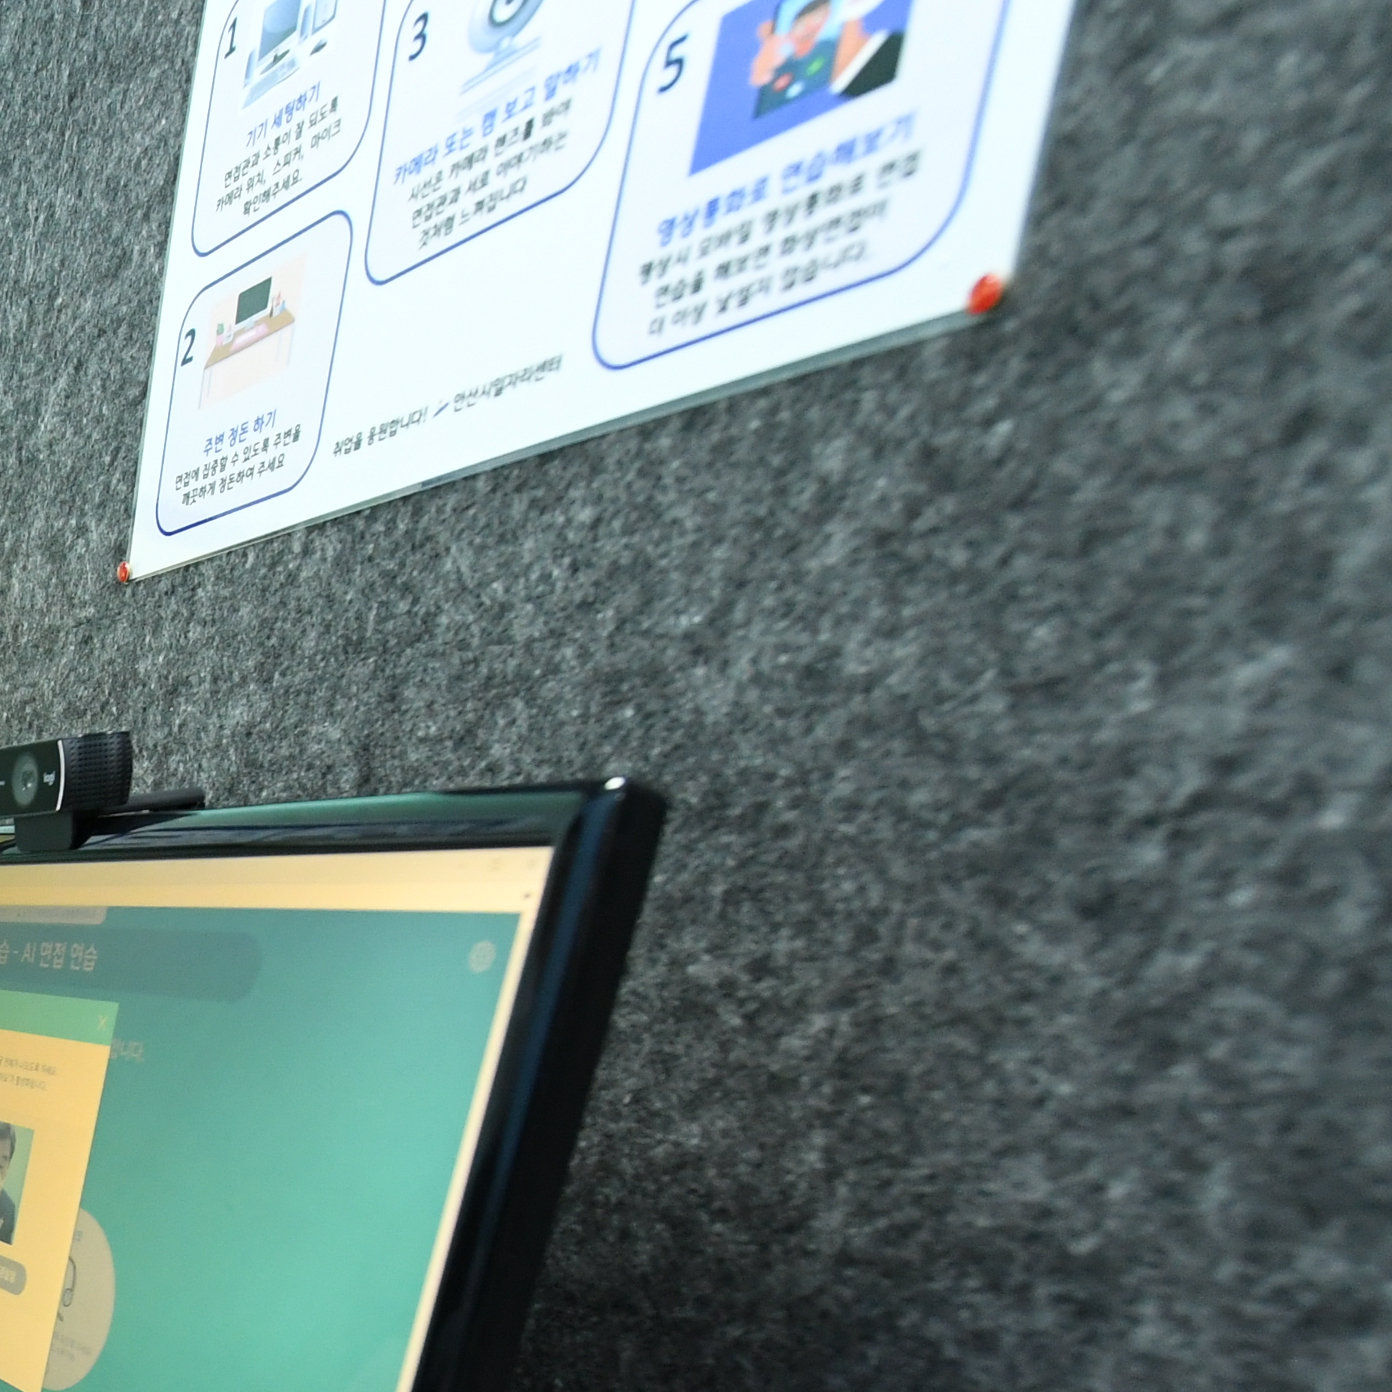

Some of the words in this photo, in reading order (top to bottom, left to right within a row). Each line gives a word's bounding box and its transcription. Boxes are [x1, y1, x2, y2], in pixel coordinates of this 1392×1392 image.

[224, 17, 237, 59] 1
[408, 11, 429, 61] 3
[657, 34, 688, 94] 5
[246, 118, 267, 148] 기기
[271, 81, 321, 129] 세팅하기
[394, 143, 438, 185] 카메라
[443, 127, 474, 157] 또는
[501, 86, 536, 123] 보고
[216, 182, 242, 212] 카메라
[310, 118, 342, 149] 마이크
[224, 150, 259, 188] 면접관과
[263, 128, 291, 159] 소통이
[294, 120, 304, 139] 잘
[308, 95, 338, 129] 되도록
[449, 144, 488, 178] 카메라
[412, 186, 461, 228] 면접관과
[419, 213, 456, 250] 것처럼
[657, 175, 769, 247] 영상통화로
[181, 328, 196, 367] 2
[453, 354, 563, 412] 안산시일자리센터
[175, 467, 200, 491] 면접에
[201, 453, 228, 480] 집중할
[230, 451, 240, 468] 수
[243, 439, 270, 462] 있도록
[272, 424, 302, 450] 주변을
[203, 434, 225, 457] 주변
[228, 419, 249, 447] 정돈
[252, 408, 278, 435] 하기
[333, 431, 363, 457] 취업을
[181, 479, 215, 506] 깨끗하게
[218, 465, 255, 493] 정돈하여
[256, 453, 285, 479] 주세요
[21, 943, 36, 963] AI
[40, 942, 67, 970] 면접
[70, 944, 98, 972] 연습
